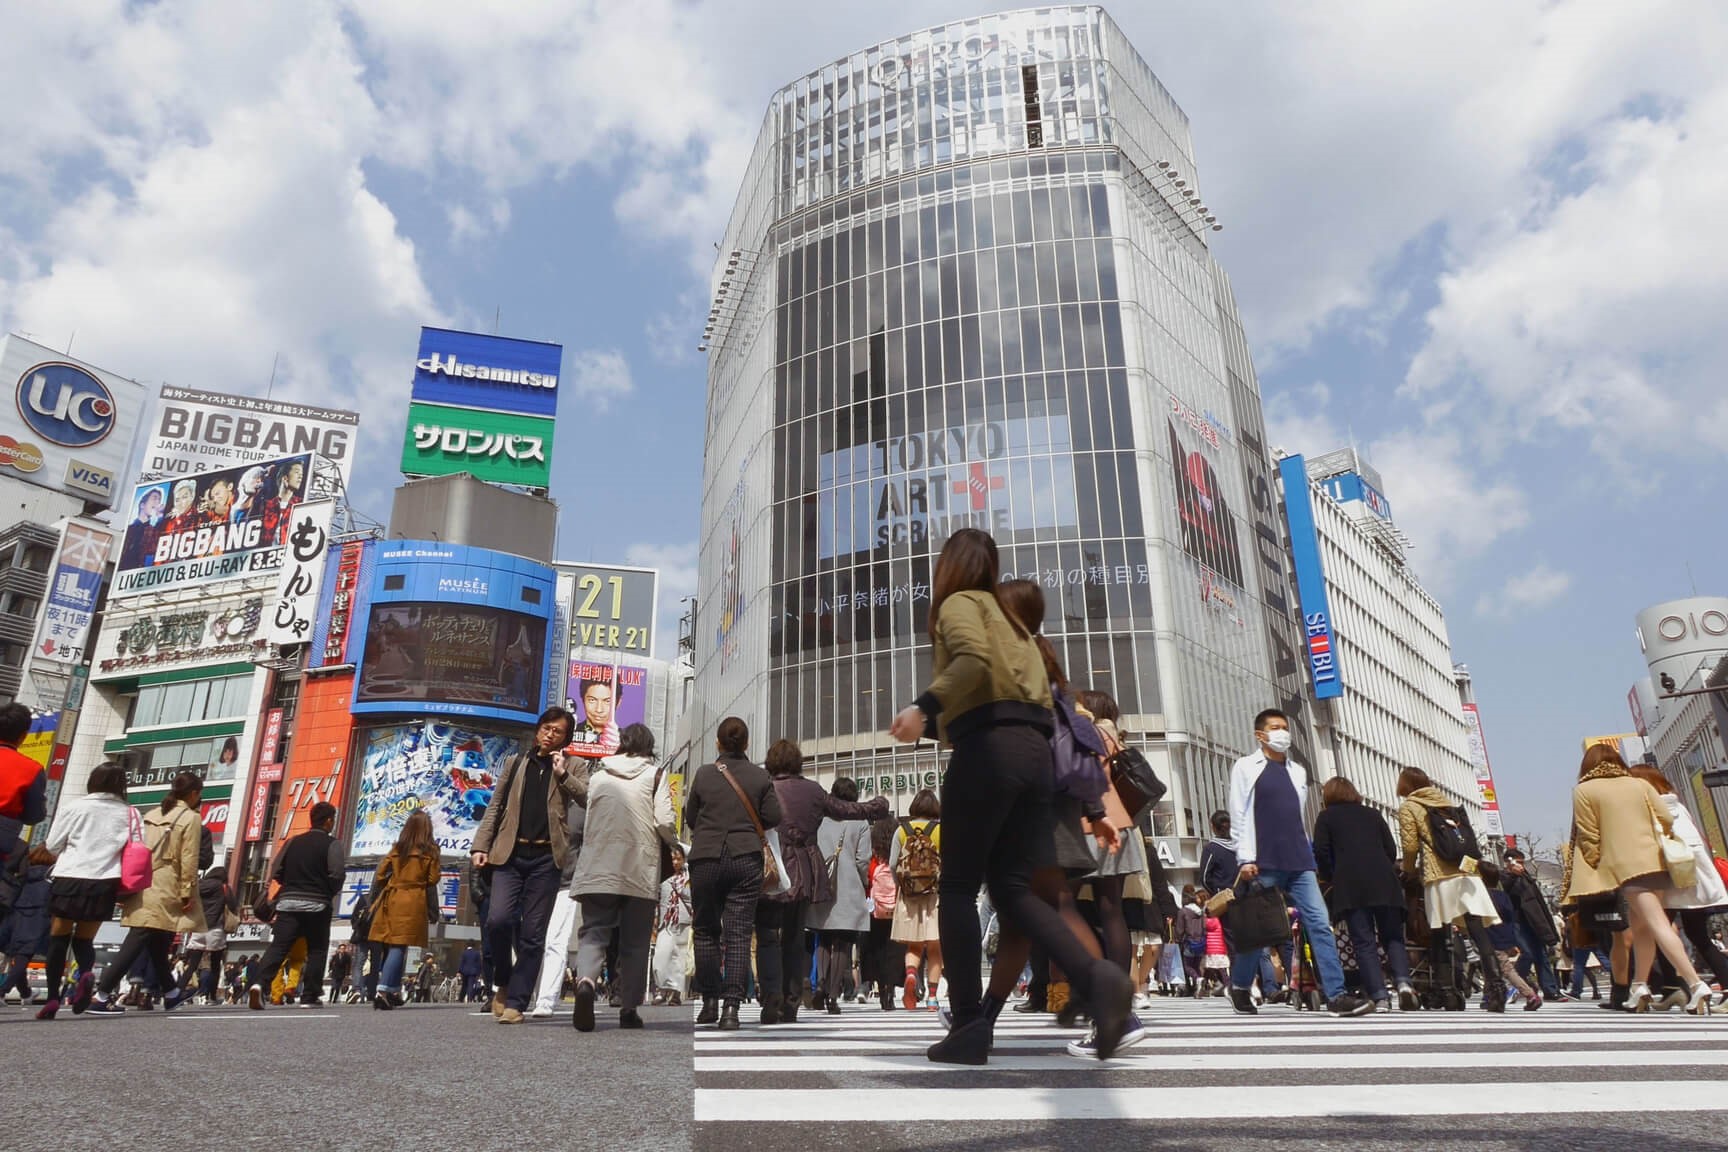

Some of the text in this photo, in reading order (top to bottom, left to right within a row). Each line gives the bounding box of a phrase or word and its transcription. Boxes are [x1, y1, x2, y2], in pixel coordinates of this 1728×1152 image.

[417, 353, 557, 388] Hisamitsu
[156, 440, 198, 454] JAPAN
[201, 444, 232, 458] DOME
[236, 448, 265, 462] TOUR
[159, 406, 348, 460] BIGBANG
[413, 423, 545, 462] サロンパス
[876, 423, 1004, 476] TOKYO
[72, 467, 110, 489] VISA
[152, 456, 189, 473] DVD
[876, 473, 953, 521] ART
[154, 519, 263, 562] BIGBANG
[877, 509, 1009, 547] SCRAMBLE
[118, 571, 148, 591] LIVE
[147, 565, 175, 587] DVD
[175, 566, 186, 581] &
[188, 555, 250, 580] BLU-RAY
[273, 516, 326, 638] もんじゃ
[576, 574, 623, 620] 21
[51, 623, 79, 639] まで
[625, 627, 648, 650] 21
[1306, 612, 1336, 683] SEIBU
[58, 645, 83, 660] 地下
[125, 766, 203, 786] Euphoa
